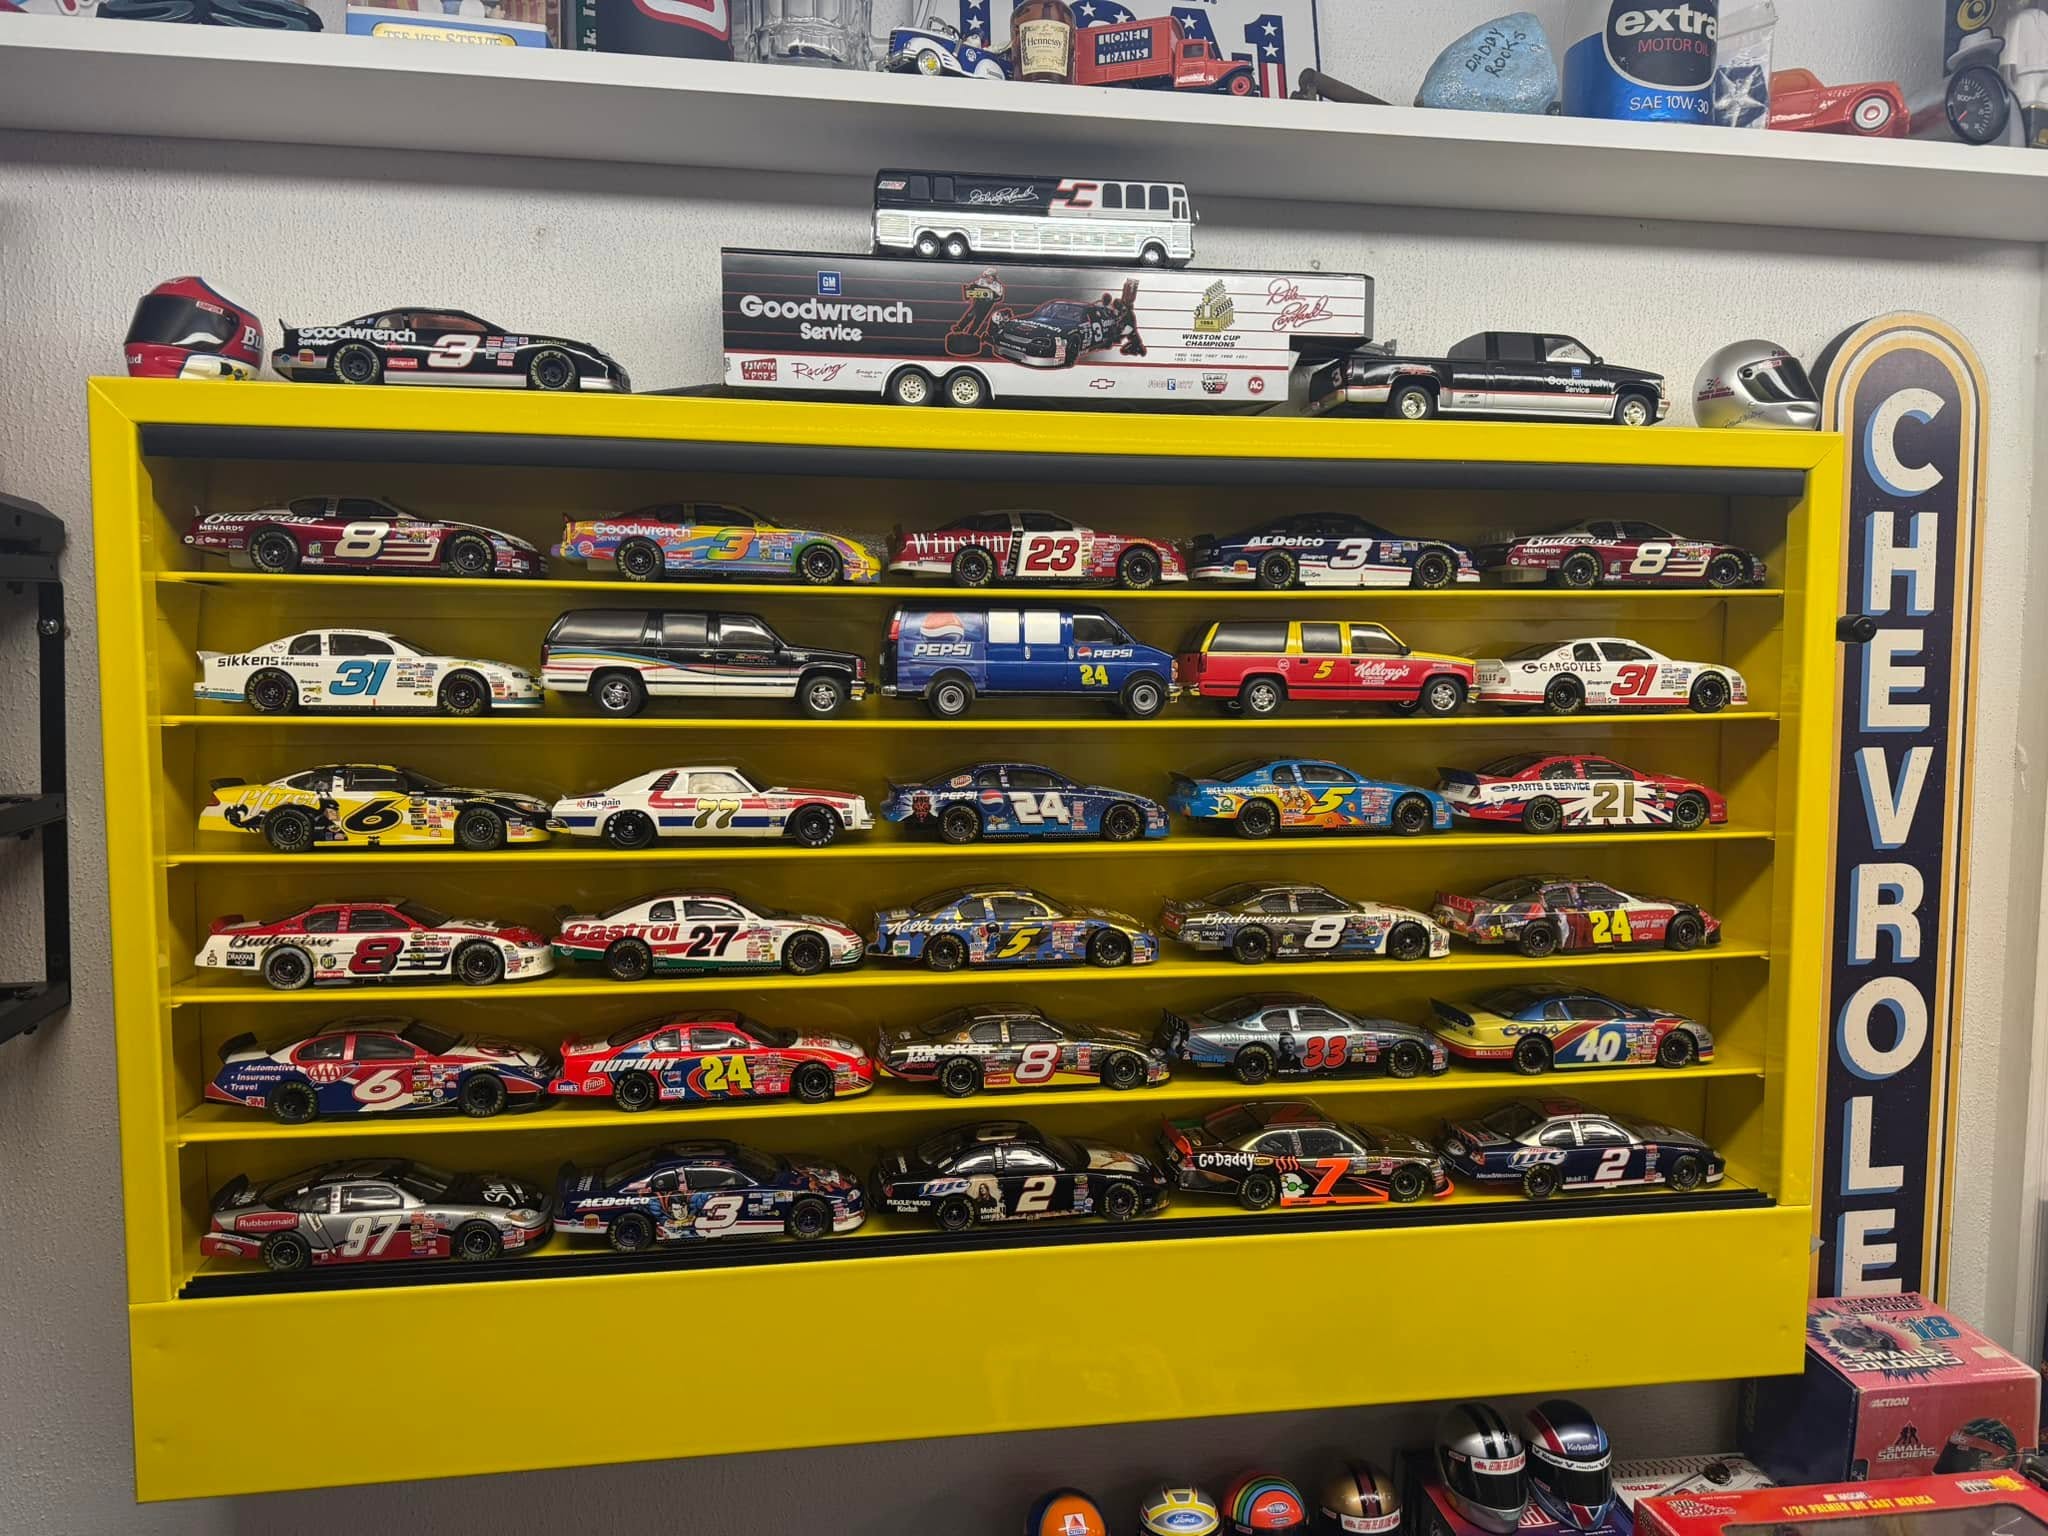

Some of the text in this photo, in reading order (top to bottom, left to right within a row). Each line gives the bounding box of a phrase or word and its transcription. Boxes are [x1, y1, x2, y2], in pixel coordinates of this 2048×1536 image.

[1616, 3, 1718, 40] extra
[1027, 37, 1063, 48] Hennessy
[1466, 27, 1506, 72] DADDY
[1638, 39, 1710, 56] MOTOR OIL
[1485, 30, 1527, 77] ROCKS
[1630, 96, 1709, 114] SAE 10W-30
[823, 276, 836, 287] GM
[740, 295, 912, 323] Goodwrench
[298, 326, 417, 343] Goodwrench
[800, 323, 863, 342] Service
[427, 334, 482, 368] 3
[1185, 340, 1236, 348] CHAMPIONS
[791, 362, 847, 382] Racing
[1250, 381, 1262, 389] AC
[1565, 385, 1591, 395] Service
[204, 511, 324, 525] Budweiser
[335, 521, 390, 557] 8
[593, 522, 691, 538] Goodwrench
[706, 528, 757, 561] 3
[911, 532, 1011, 555] Winston
[1249, 536, 1325, 547] ACDelco
[1527, 537, 1622, 547] Budweiser
[1025, 536, 1081, 572] 23
[1329, 538, 1373, 570] 3
[1630, 543, 1672, 575] 8
[913, 643, 974, 657] PEPSI
[1093, 649, 1134, 658] PEPSI
[217, 655, 279, 668] sikkens
[1313, 660, 1335, 679] 5
[1354, 659, 1410, 681] Kellogg's
[1539, 662, 1602, 673] GARGOYLES
[329, 659, 392, 696] 31
[1079, 664, 1110, 686] 24
[1611, 664, 1658, 696] 31
[940, 790, 978, 801] PEPSI
[1511, 783, 1544, 792] PARTS
[1553, 782, 1591, 791] SERVICE
[586, 797, 621, 809] hy-gain
[1008, 791, 1070, 825] 24
[1304, 787, 1357, 815] 5
[1592, 782, 1635, 818] 21
[342, 795, 403, 834] 6
[694, 799, 742, 829] 77
[1201, 914, 1294, 925] Budweiser
[1588, 910, 1632, 944] 24
[229, 935, 339, 949] Budweiser
[564, 923, 680, 942] Castrol
[686, 923, 739, 958] 27
[1303, 917, 1347, 949] 8
[996, 927, 1042, 958] 5
[348, 937, 404, 974] 8
[1502, 1024, 1560, 1037] Coors
[907, 1045, 993, 1056] TRACKER
[1303, 1036, 1347, 1069] 33
[1576, 1030, 1621, 1062] 40
[244, 1064, 296, 1072] Automotive
[588, 1058, 680, 1073] DUPONT
[907, 1055, 936, 1063] BOATS
[1015, 1044, 1060, 1083] 8
[237, 1073, 282, 1082] Insurance
[311, 1065, 341, 1080] AAA
[700, 1055, 753, 1091] 24
[231, 1083, 258, 1091] Travel
[353, 1070, 408, 1103] 6
[1595, 1147, 1632, 1181] 2
[1312, 1158, 1351, 1196] 7
[576, 1197, 650, 1209] ACDelco
[1016, 1175, 1057, 1213] 2
[239, 1216, 296, 1228] Rubbermaid
[695, 1196, 744, 1230] 3
[342, 1216, 403, 1257] 97
[1838, 1295, 1919, 1306] INTERSTATE
[1850, 1303, 1923, 1314] BATTERIES
[1908, 1315, 1962, 1341] 18
[1839, 1353, 1966, 1373] SOLDIERS
[1850, 1348, 1934, 1362] SMALL
[1871, 1397, 1910, 1408] ACTION
[1878, 1448, 1939, 1460] SOLDIERS
[1887, 1444, 1927, 1453] SMALL
[1782, 1495, 1937, 1516] 1/24 PREMIER DIE CAST REPLICA
[1172, 1514, 1197, 1525] Ford
